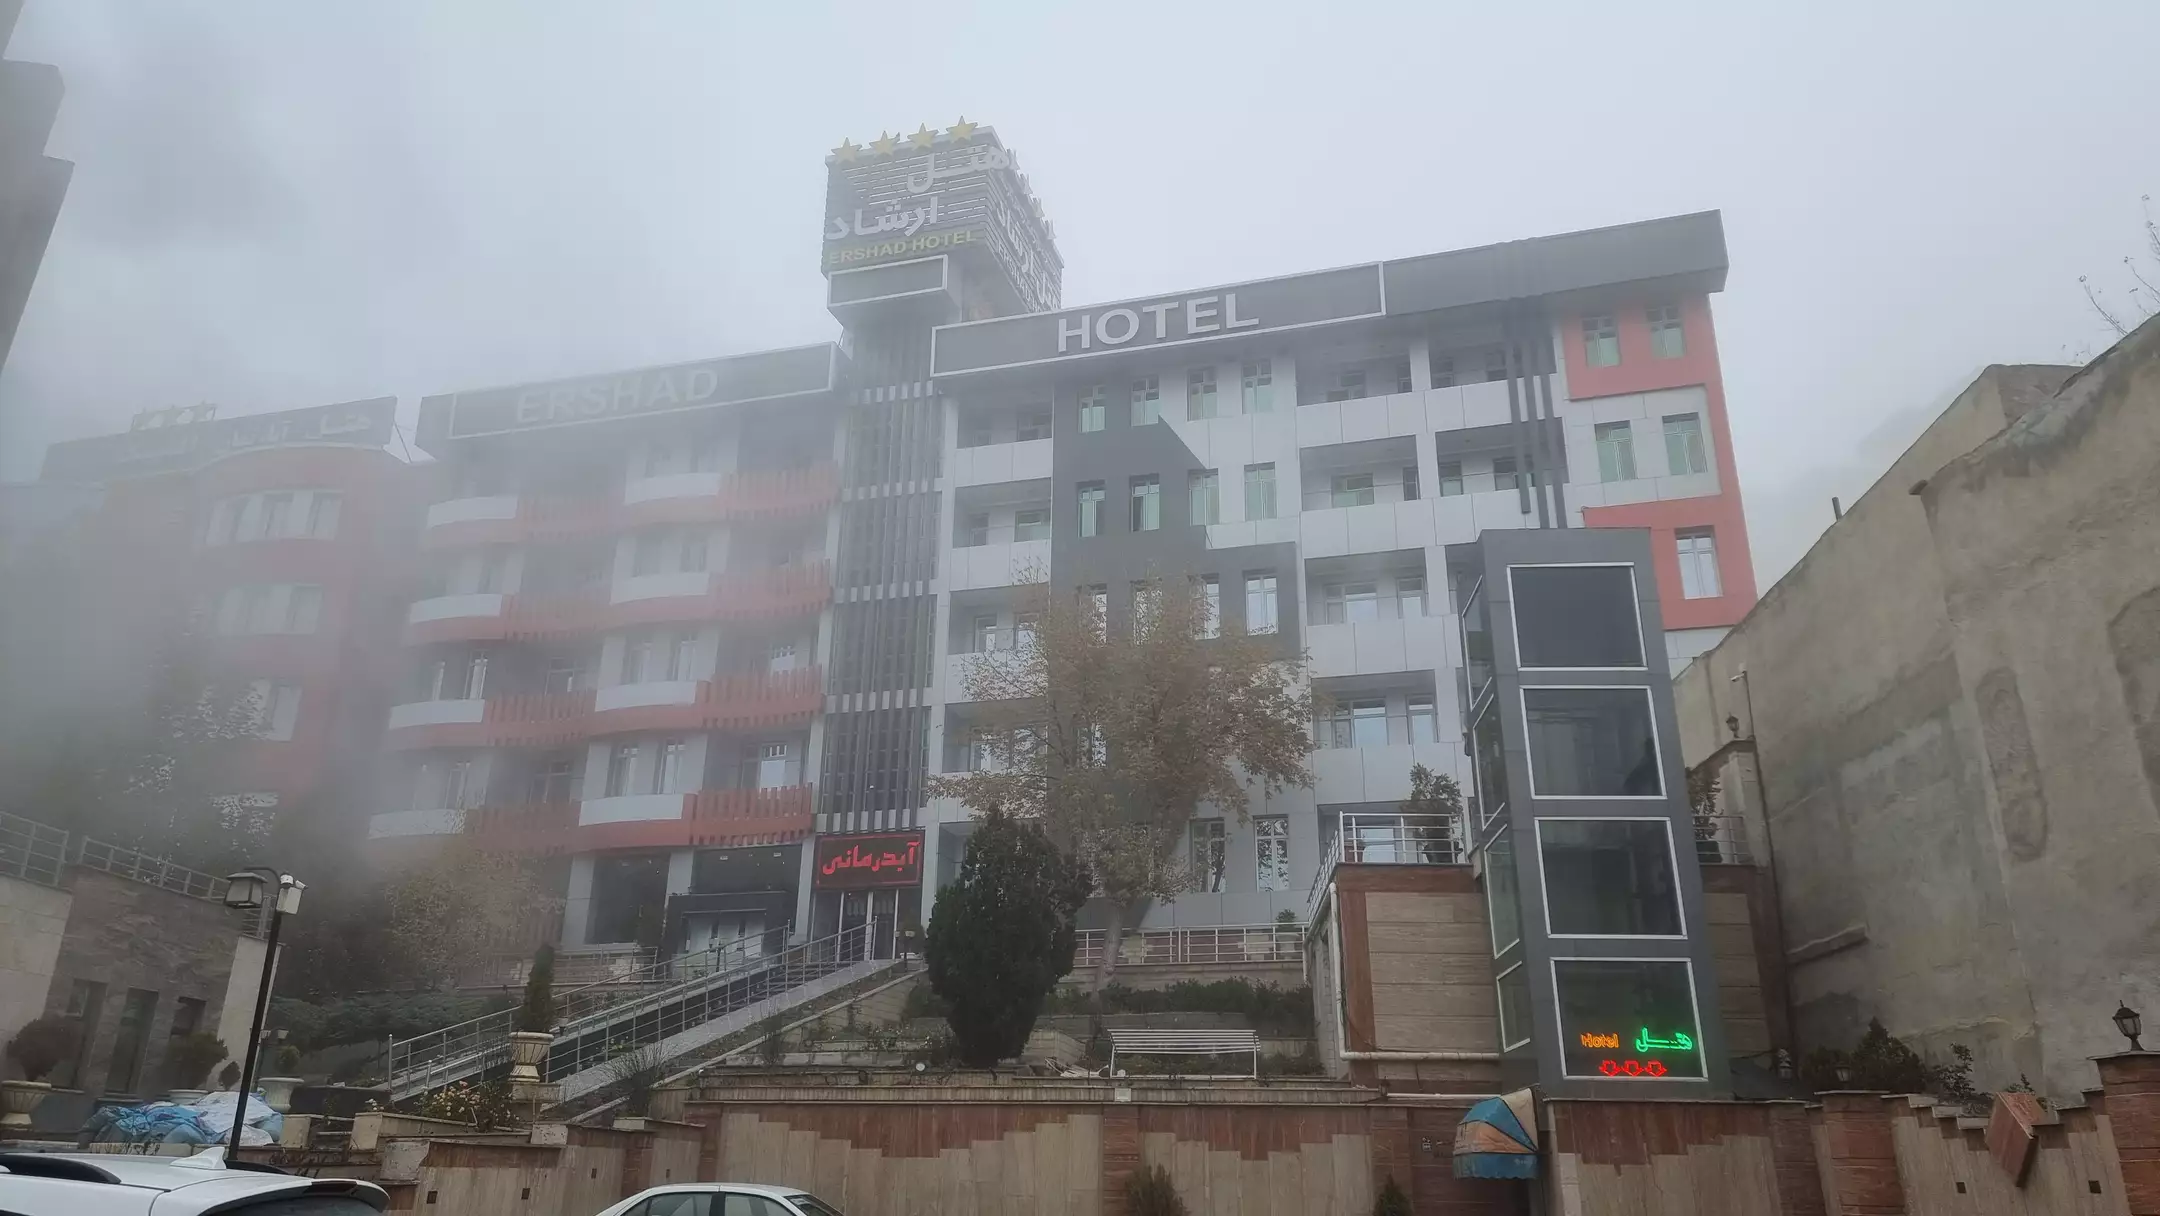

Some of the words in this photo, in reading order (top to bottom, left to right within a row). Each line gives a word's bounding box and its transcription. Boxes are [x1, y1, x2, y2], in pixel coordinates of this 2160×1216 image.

[907, 146, 1009, 194] هتل
[825, 196, 938, 240] ارشاد
[828, 240, 907, 265] ERSHAD
[912, 229, 977, 253] HOTEL
[1057, 292, 1260, 353] HOTEL
[515, 367, 719, 424] ERSHAD
[1580, 1032, 1620, 1049] Hotel
[1635, 1026, 1693, 1053] هتل
